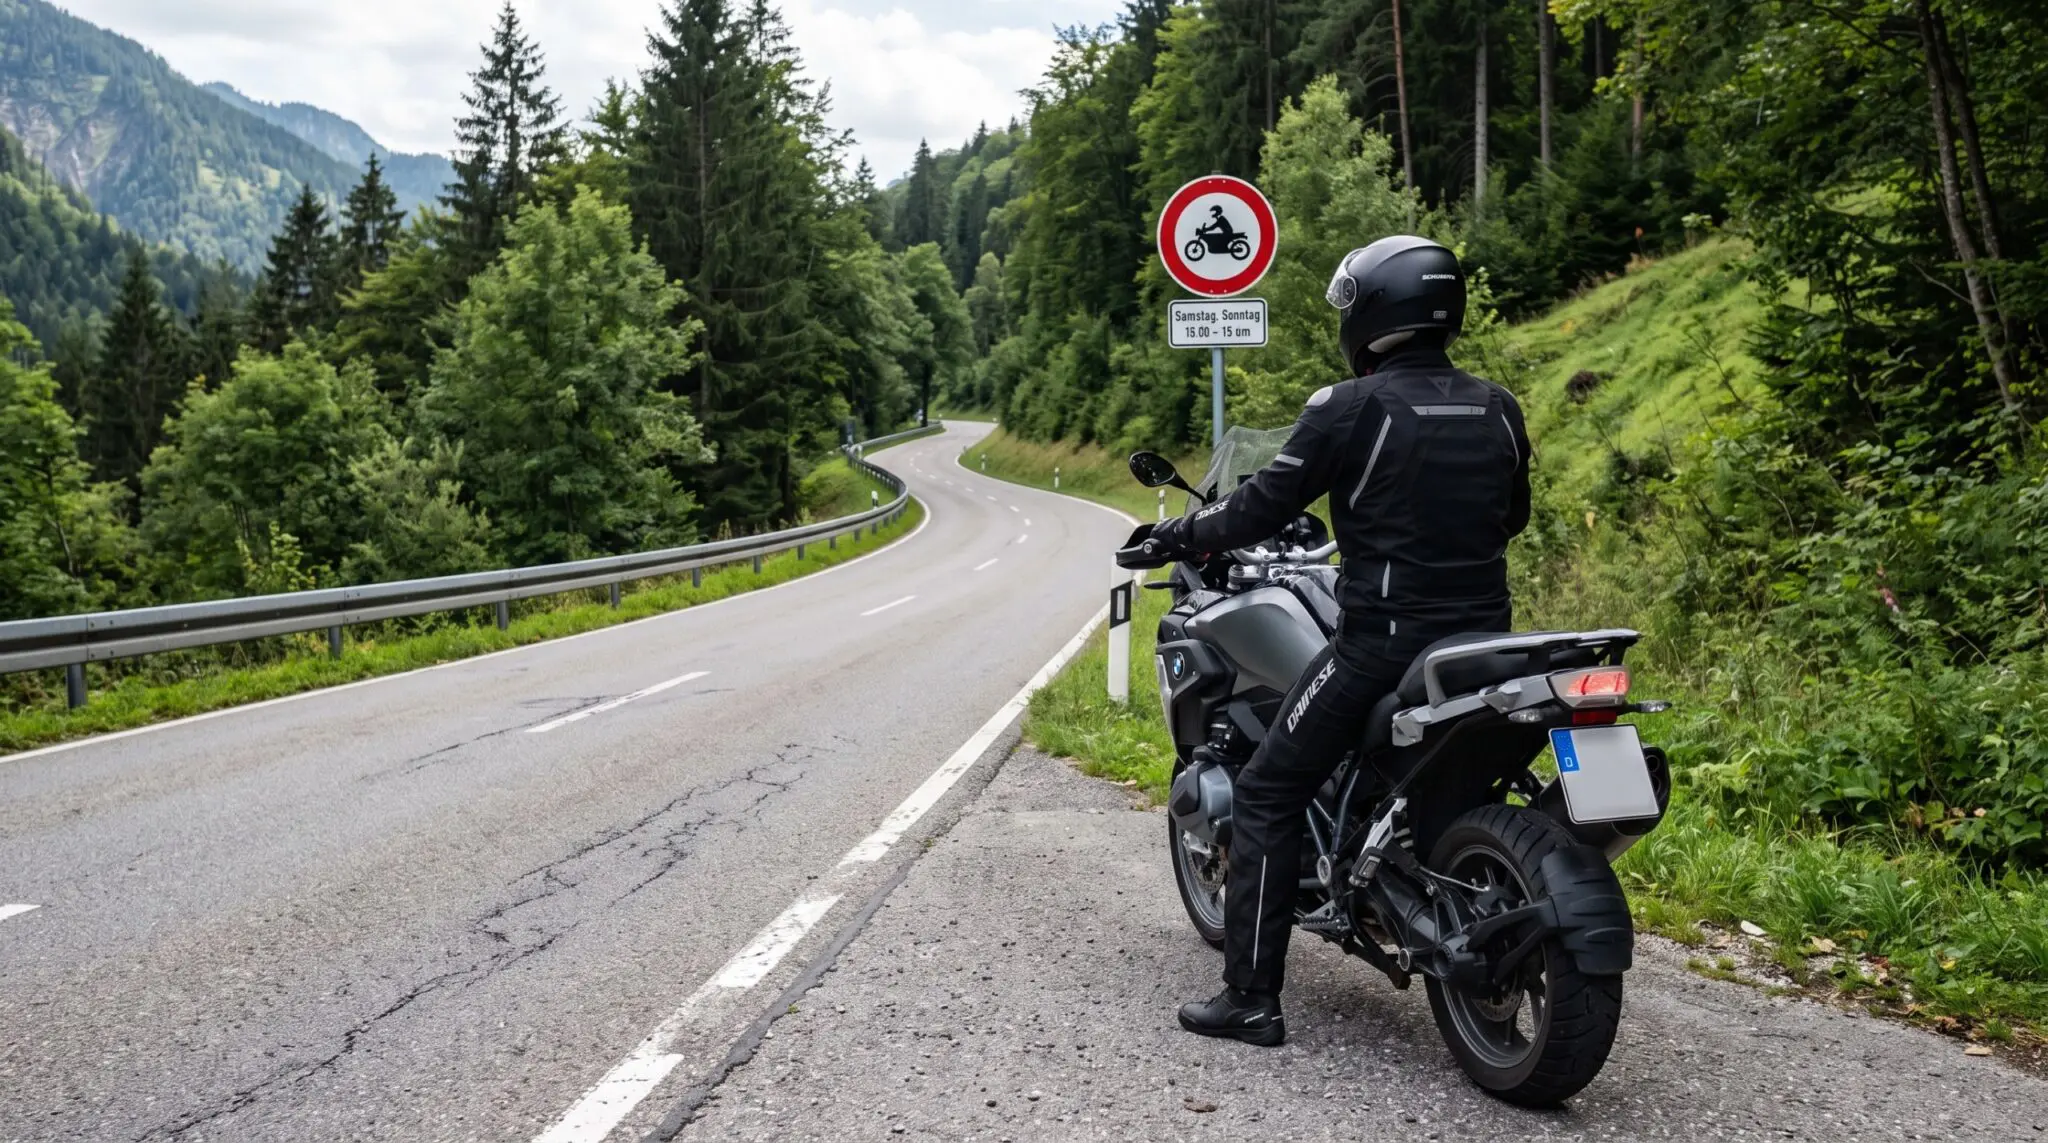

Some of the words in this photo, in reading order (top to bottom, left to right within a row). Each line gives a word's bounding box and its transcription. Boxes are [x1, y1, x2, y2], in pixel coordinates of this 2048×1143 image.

[1222, 309, 1260, 323] Sonntag
[1222, 326, 1233, 338] 15
[1287, 658, 1336, 734] DAINESE
[1564, 756, 1573, 768] D
